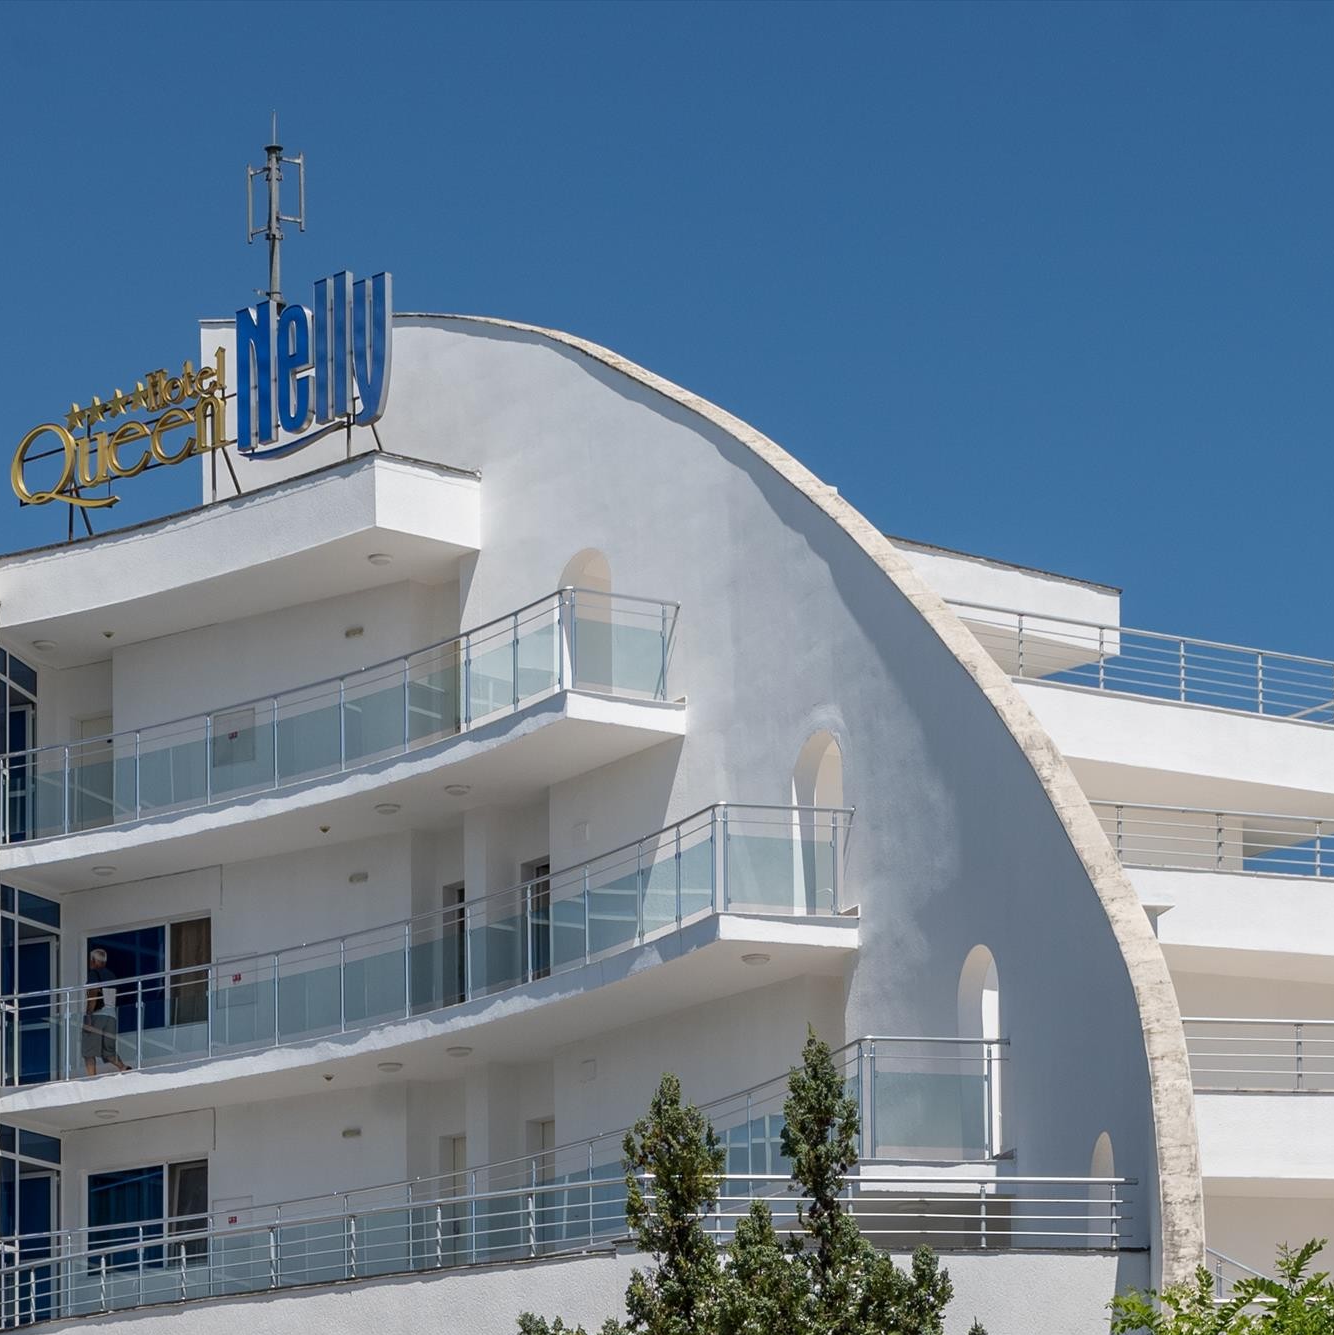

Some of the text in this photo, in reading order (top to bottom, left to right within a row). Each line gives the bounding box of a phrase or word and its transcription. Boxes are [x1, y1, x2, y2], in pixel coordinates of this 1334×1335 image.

[11, 270, 393, 507] Queen Nelly
[145, 346, 227, 412] Hotel
